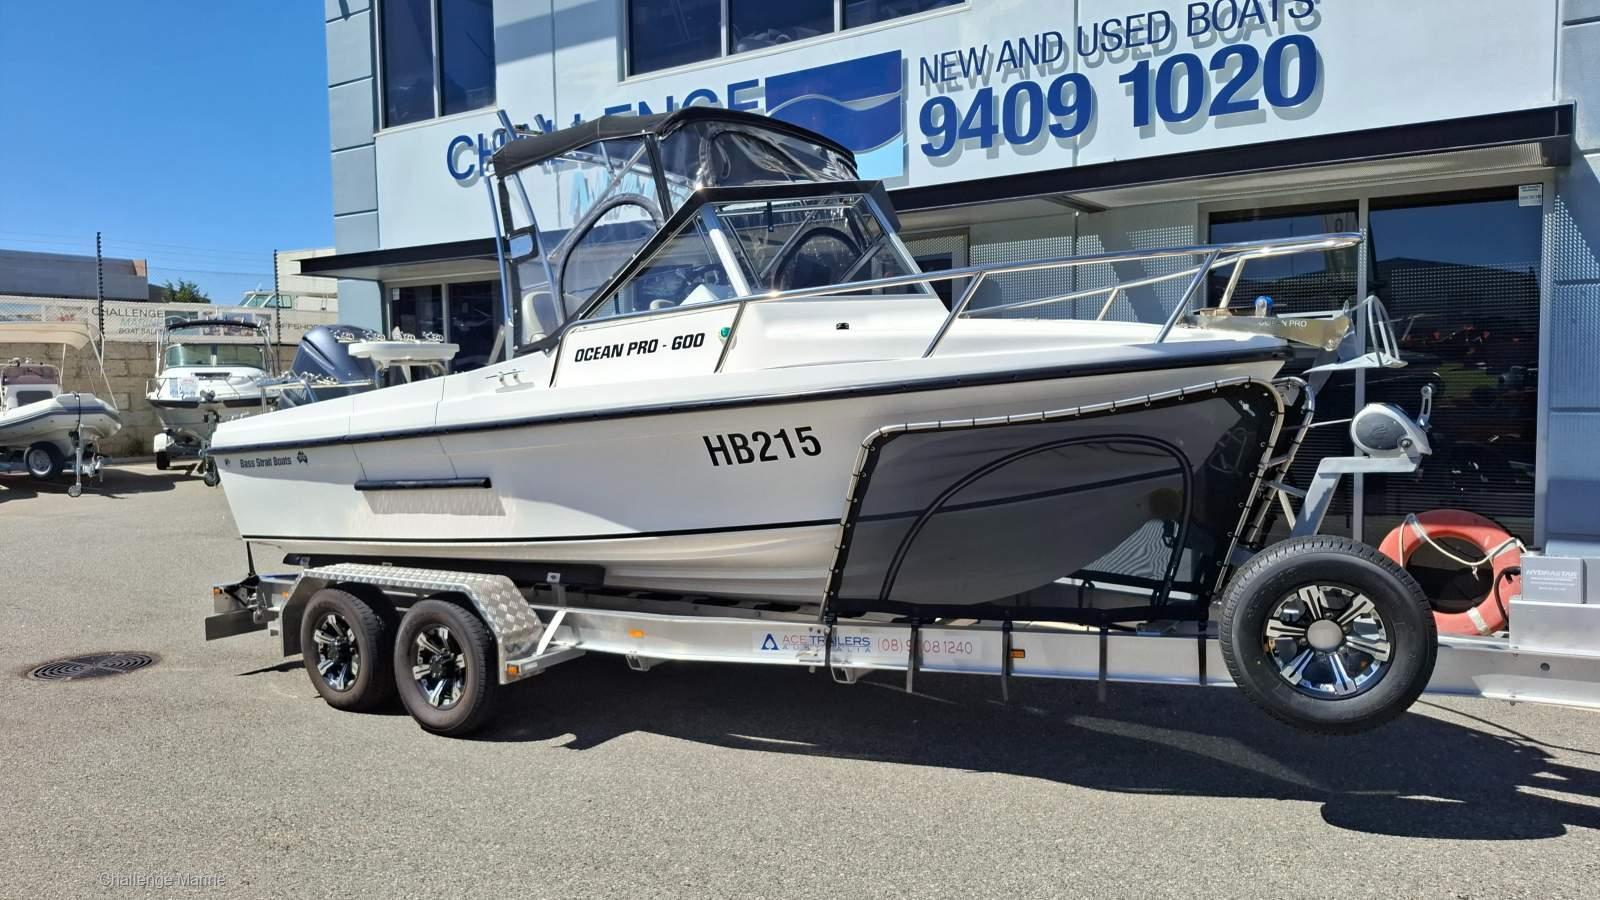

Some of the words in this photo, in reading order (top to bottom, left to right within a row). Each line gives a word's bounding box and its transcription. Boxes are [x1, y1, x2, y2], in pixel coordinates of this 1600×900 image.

[919, 44, 988, 86] NEW
[996, 31, 1063, 73] AND
[1077, 10, 1171, 57] USED
[1187, 0, 1314, 37] BOATS
[919, 72, 1092, 157] 9409
[1119, 34, 1317, 128] 1020
[1289, 319, 1308, 328] PRO
[574, 343, 624, 362] OCEAN
[626, 339, 659, 356] PRO
[671, 332, 705, 350] 600
[703, 426, 822, 467] HB215
[240, 459, 256, 468] Bass
[783, 634, 808, 645] ACE
[877, 638, 903, 653] (08)
[905, 639, 941, 654] 908
[943, 640, 973, 655] 1240
